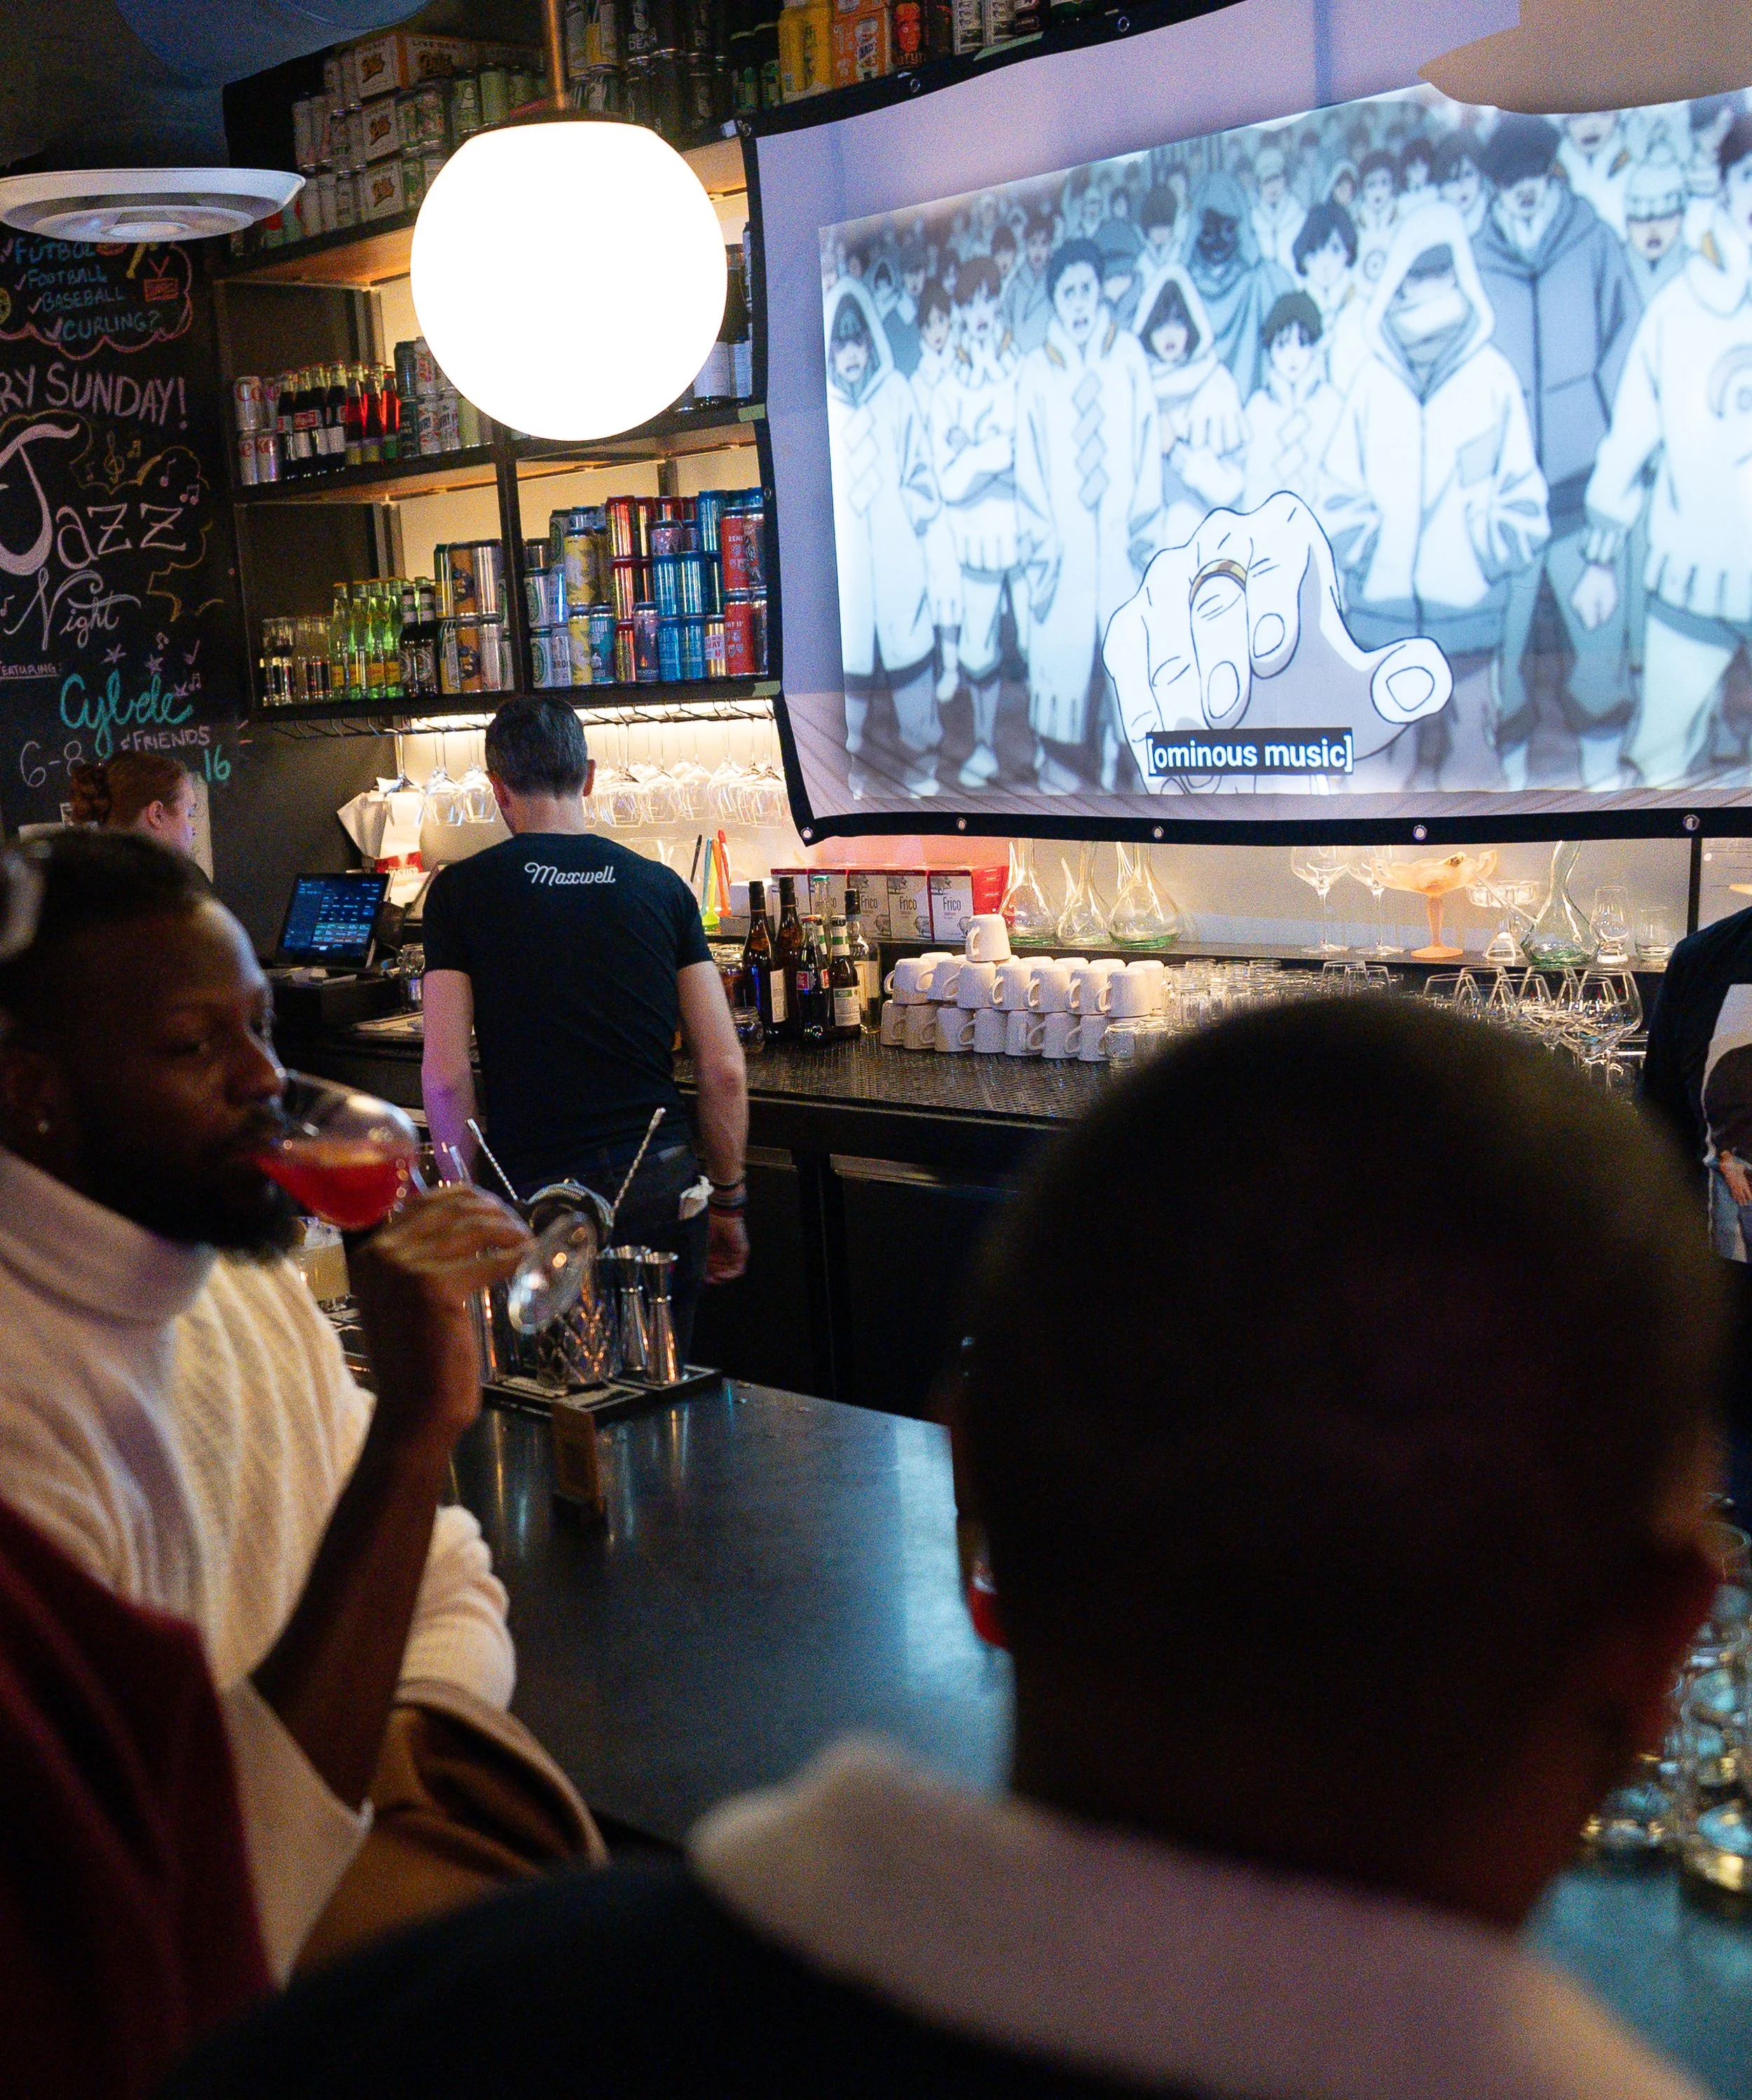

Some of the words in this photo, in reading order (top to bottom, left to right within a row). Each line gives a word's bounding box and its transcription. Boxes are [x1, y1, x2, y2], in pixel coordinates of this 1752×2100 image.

[42, 286, 125, 313] BASEBALL
[45, 362, 188, 430] SUNDAY!
[4, 567, 141, 650] Night
[0, 660, 62, 676] EATURING:
[132, 725, 211, 751] FRIENDS
[204, 743, 231, 782] 16
[1147, 737, 1257, 775] [ominous
[1264, 734, 1353, 773] music]
[525, 862, 616, 886] Maxwell
[861, 895, 878, 910] Frico
[899, 896, 917, 911] Frico
[943, 896, 961, 911] Frico
